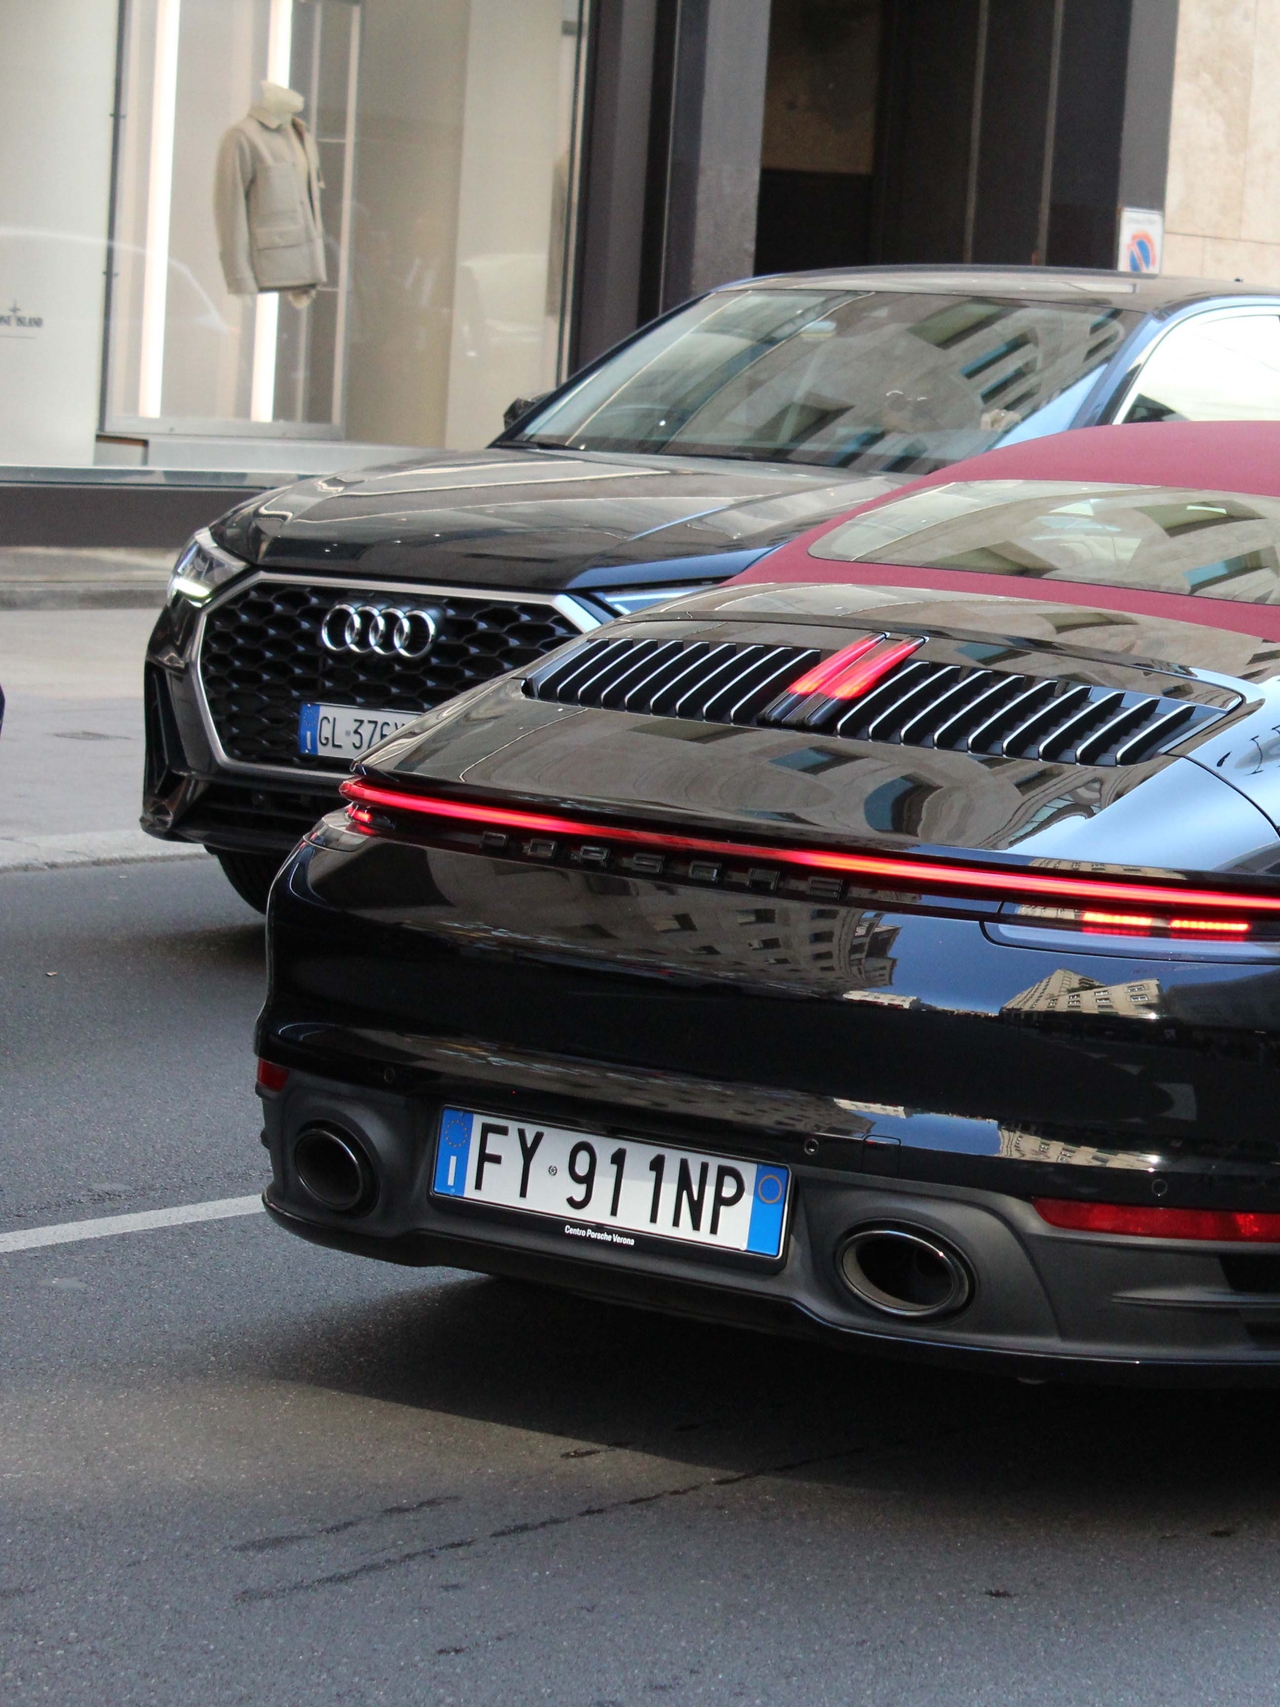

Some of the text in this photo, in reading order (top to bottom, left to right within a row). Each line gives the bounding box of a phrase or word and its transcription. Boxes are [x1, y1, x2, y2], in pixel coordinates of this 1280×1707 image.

[318, 716, 406, 750] GL 376
[480, 830, 844, 900] PORSCHE
[474, 1121, 545, 1199] FY
[565, 1225, 635, 1246] Centro Porsche Verona
